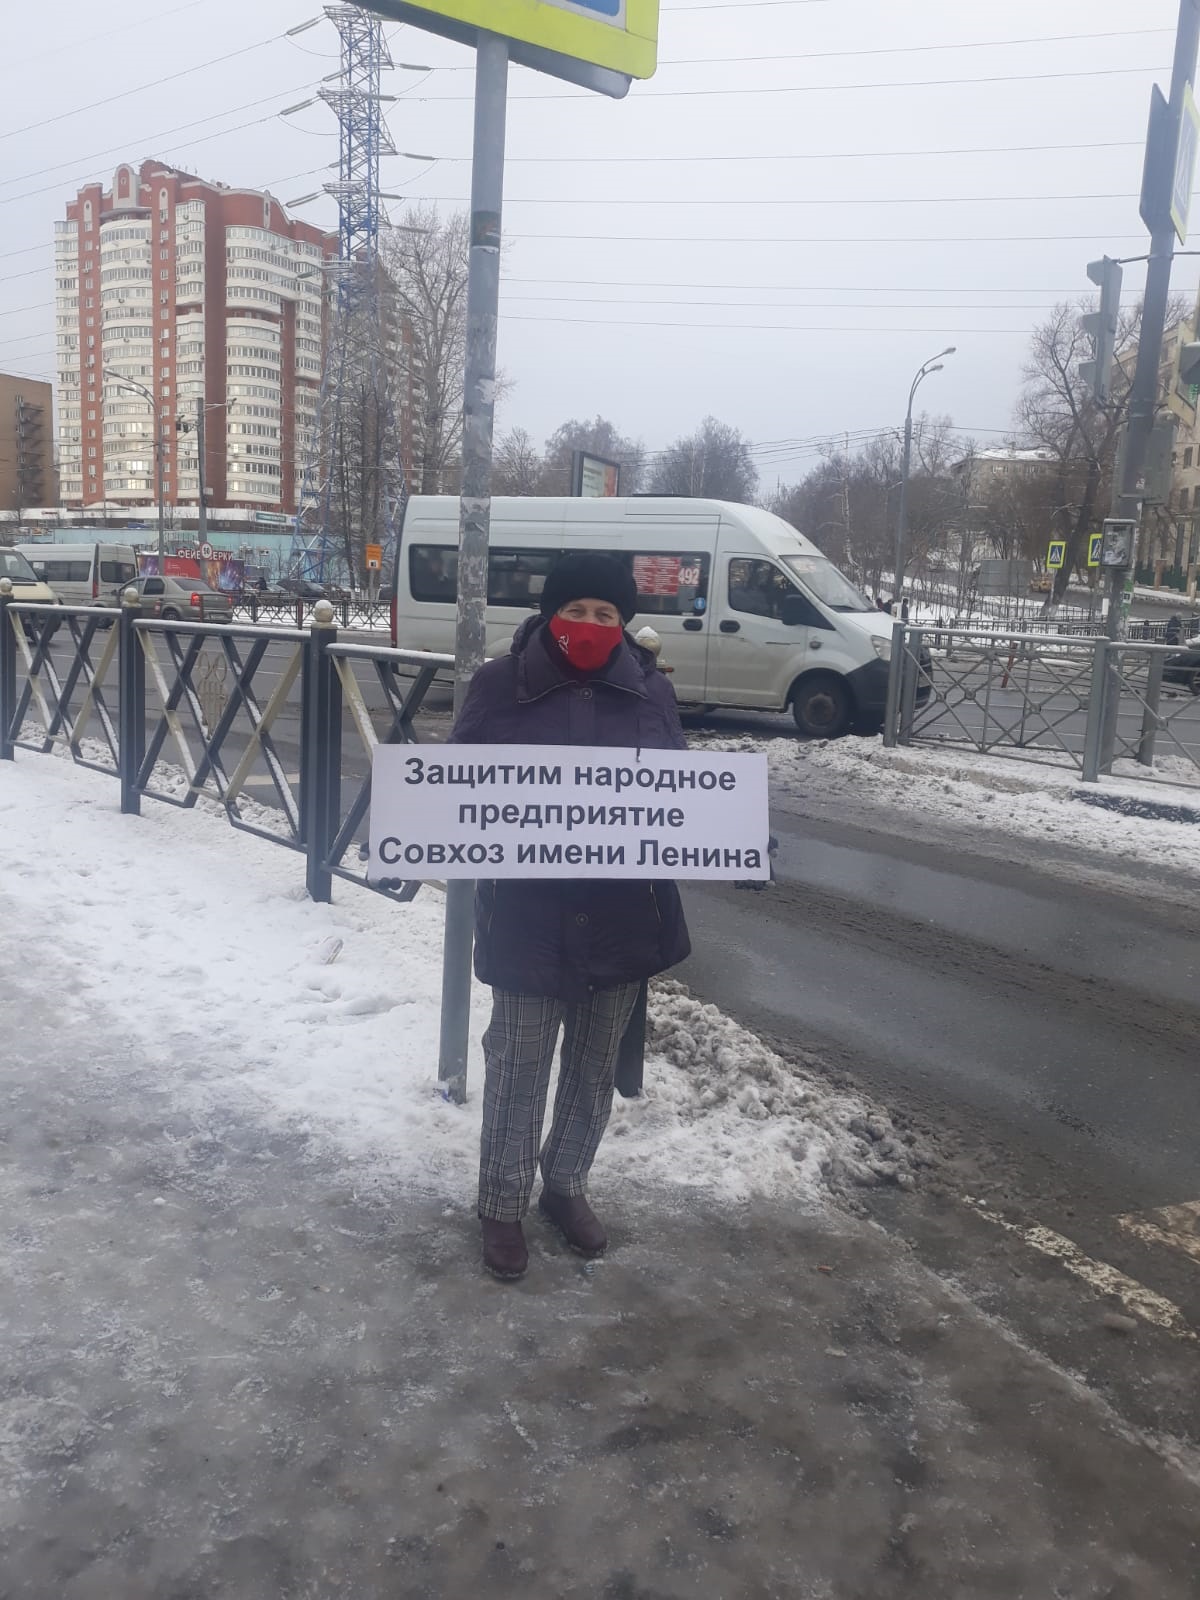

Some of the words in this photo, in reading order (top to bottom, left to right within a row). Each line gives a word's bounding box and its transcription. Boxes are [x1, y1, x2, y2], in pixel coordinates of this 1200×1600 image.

[177, 549, 234, 560] ФЕЙЕЕРКИ
[679, 567, 700, 585] 492
[404, 757, 562, 789] Защитим
[574, 766, 736, 793] народное
[459, 803, 685, 831] предприятие
[378, 836, 505, 864] Совхоз
[517, 843, 625, 865] имени
[636, 839, 762, 868] Ленина
